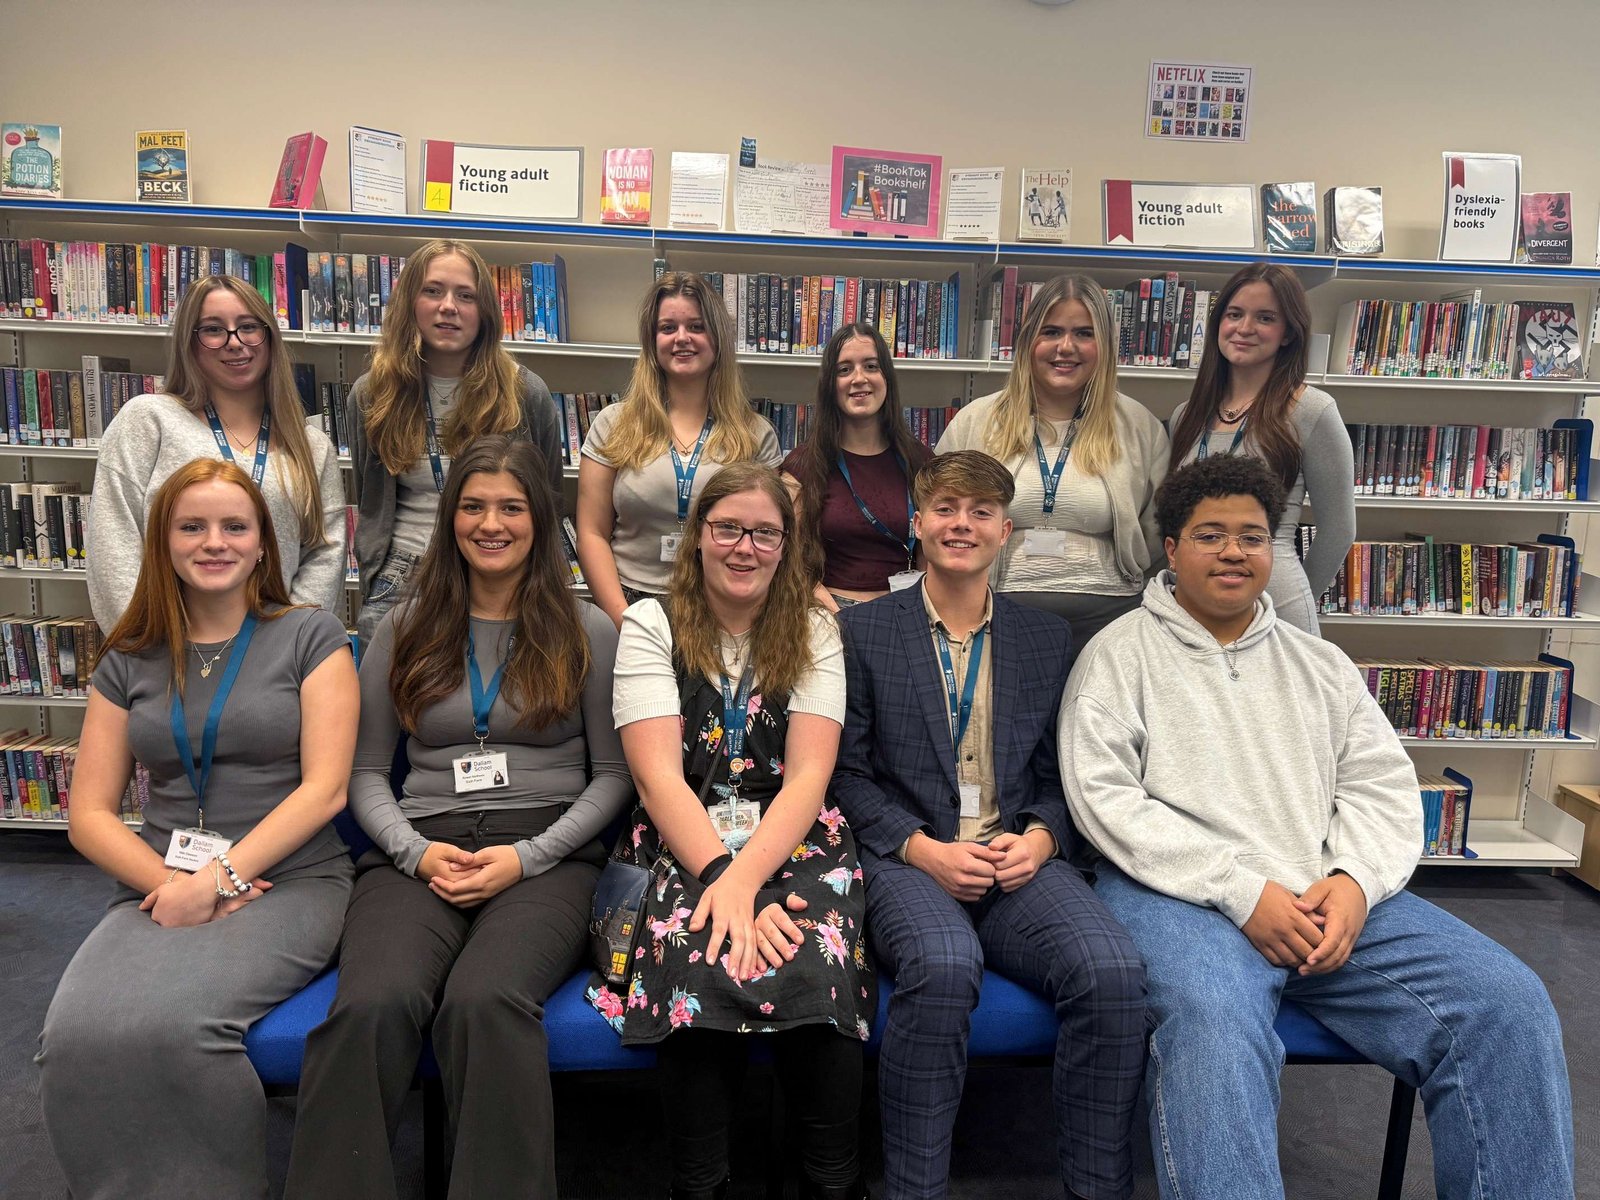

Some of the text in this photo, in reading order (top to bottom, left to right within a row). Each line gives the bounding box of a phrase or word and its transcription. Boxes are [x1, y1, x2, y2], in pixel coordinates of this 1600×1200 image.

[1157, 66, 1206, 84] NETFLIX
[140, 136, 182, 148] MAL PEET
[16, 163, 49, 174] POTION
[460, 164, 549, 182] Young adult
[874, 164, 928, 178] #BookTok
[16, 173, 49, 184] DIARIES
[618, 180, 635, 189] IS NO
[874, 176, 926, 189] Bookshelf
[1025, 173, 1069, 188] The Help
[144, 182, 182, 193] BECK
[459, 178, 509, 194] fiction
[1274, 200, 1298, 212] the
[1455, 194, 1505, 206] Dyslexia-
[1138, 200, 1223, 216] Young adult
[1454, 206, 1496, 218] friendly
[1138, 214, 1186, 227] fiction
[1453, 219, 1485, 229] books
[1532, 240, 1568, 248] DIVERGENT
[49, 259, 58, 295] SOUND
[1165, 282, 1176, 317] ROCK WAR
[1184, 291, 1192, 319] NESS
[87, 393, 96, 418] WOLVES
[1398, 671, 1406, 700] EXTRAS
[1402, 670, 1415, 710] SPECIALS
[192, 845, 212, 853] School
[193, 839, 214, 847] Dallam
